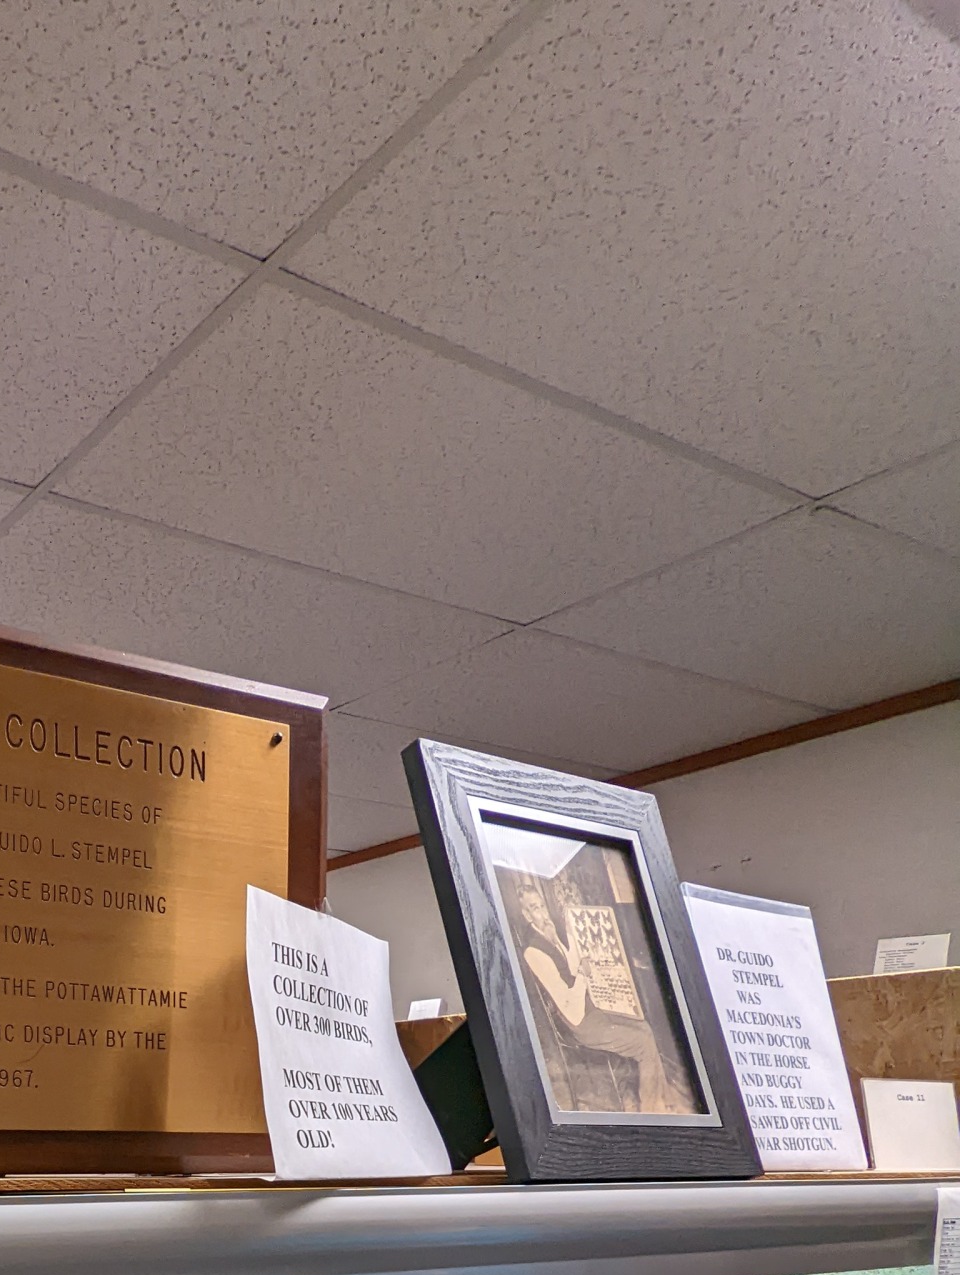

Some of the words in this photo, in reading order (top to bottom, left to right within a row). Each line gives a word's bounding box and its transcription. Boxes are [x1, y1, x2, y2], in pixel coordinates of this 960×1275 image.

[5, 713, 206, 783] COLLECTION
[54, 792, 133, 822] SPECIES
[141, 804, 163, 825] OF
[51, 838, 65, 858] L.
[71, 841, 152, 870] STEMPEL
[40, 882, 94, 906] BIRDS
[102, 890, 167, 915] DURING
[4, 924, 55, 948] IOWA.
[271, 942, 303, 971] THIS
[305, 952, 318, 974] IS
[320, 958, 329, 977] A
[716, 947, 736, 964] DR.
[737, 950, 774, 968] GUIDO
[732, 969, 784, 989] STEMPEL
[0, 976, 36, 998] THE
[45, 980, 188, 1010] POTTAWATTAMIE
[272, 974, 352, 1014] COLLECTION
[354, 997, 369, 1018] OF
[736, 989, 762, 1006] WAS
[23, 1024, 98, 1047] DISPLAY
[106, 1030, 126, 1048] BY
[134, 1031, 166, 1050] THE
[276, 1006, 312, 1033] OVER
[313, 1015, 331, 1037] 300
[334, 1020, 373, 1048] BIRDS,
[730, 1030, 765, 1046] TOWN
[766, 1033, 812, 1050] DOCTOR
[734, 1051, 748, 1066] IN
[749, 1052, 772, 1068] THE
[774, 1054, 810, 1070] HORSE
[282, 1068, 321, 1092] MOST
[324, 1074, 342, 1093] OF
[342, 1076, 384, 1096] THEM
[741, 1072, 764, 1088] AND
[765, 1074, 802, 1090] BUGGY
[745, 1093, 778, 1109] DAYS.
[780, 1095, 797, 1110] HE
[798, 1096, 826, 1110] USED
[827, 1098, 835, 1110] A
[896, 1094, 914, 1102] Case
[288, 1099, 332, 1120] OVER
[331, 1102, 354, 1121] 100
[353, 1104, 398, 1123] YEARS
[750, 1115, 790, 1130] SAWED
[790, 1116, 810, 1130] OFF
[812, 1116, 842, 1131] CIVIL
[296, 1128, 336, 1149] OLD!
[755, 1136, 782, 1151] WAR
[782, 1136, 837, 1151] SHOTGUN.
